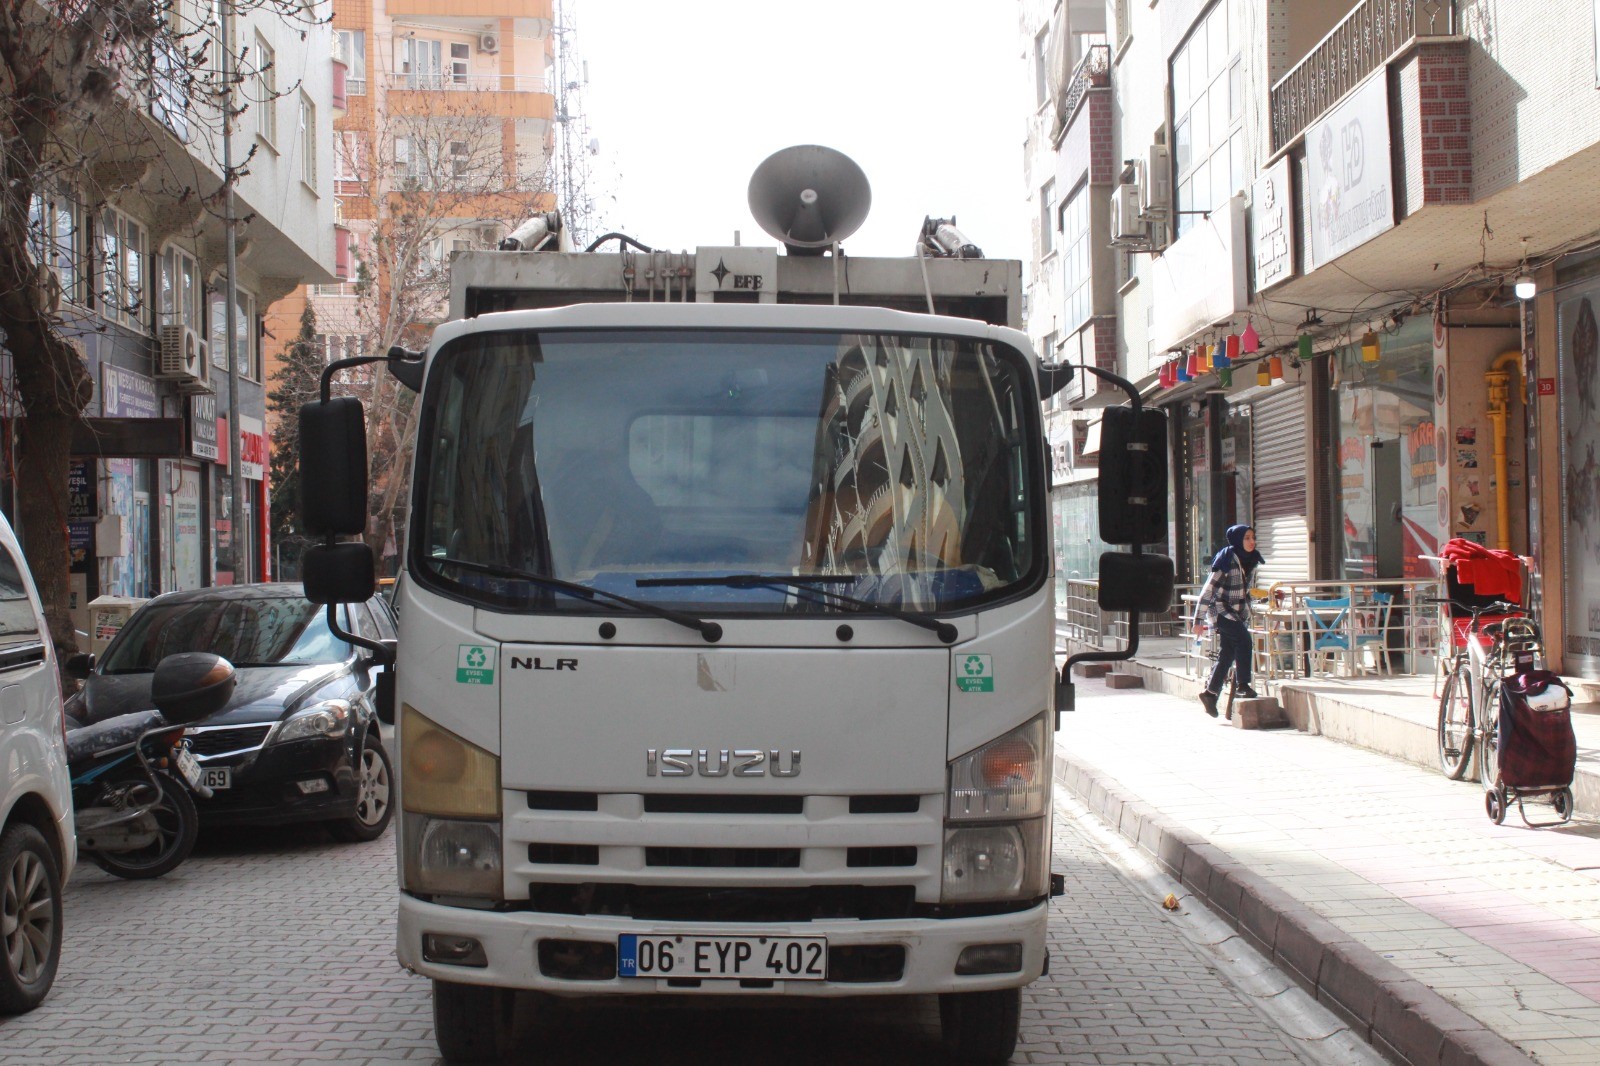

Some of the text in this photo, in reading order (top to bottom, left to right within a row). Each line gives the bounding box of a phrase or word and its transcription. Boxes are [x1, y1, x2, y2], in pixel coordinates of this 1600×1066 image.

[734, 275, 763, 290] EFE
[1528, 347, 1536, 450] BAYAN
[511, 656, 579, 671] NLR
[647, 749, 801, 777] ISUZU
[622, 959, 635, 968] TR
[638, 940, 822, 974] 06 EYP 402
